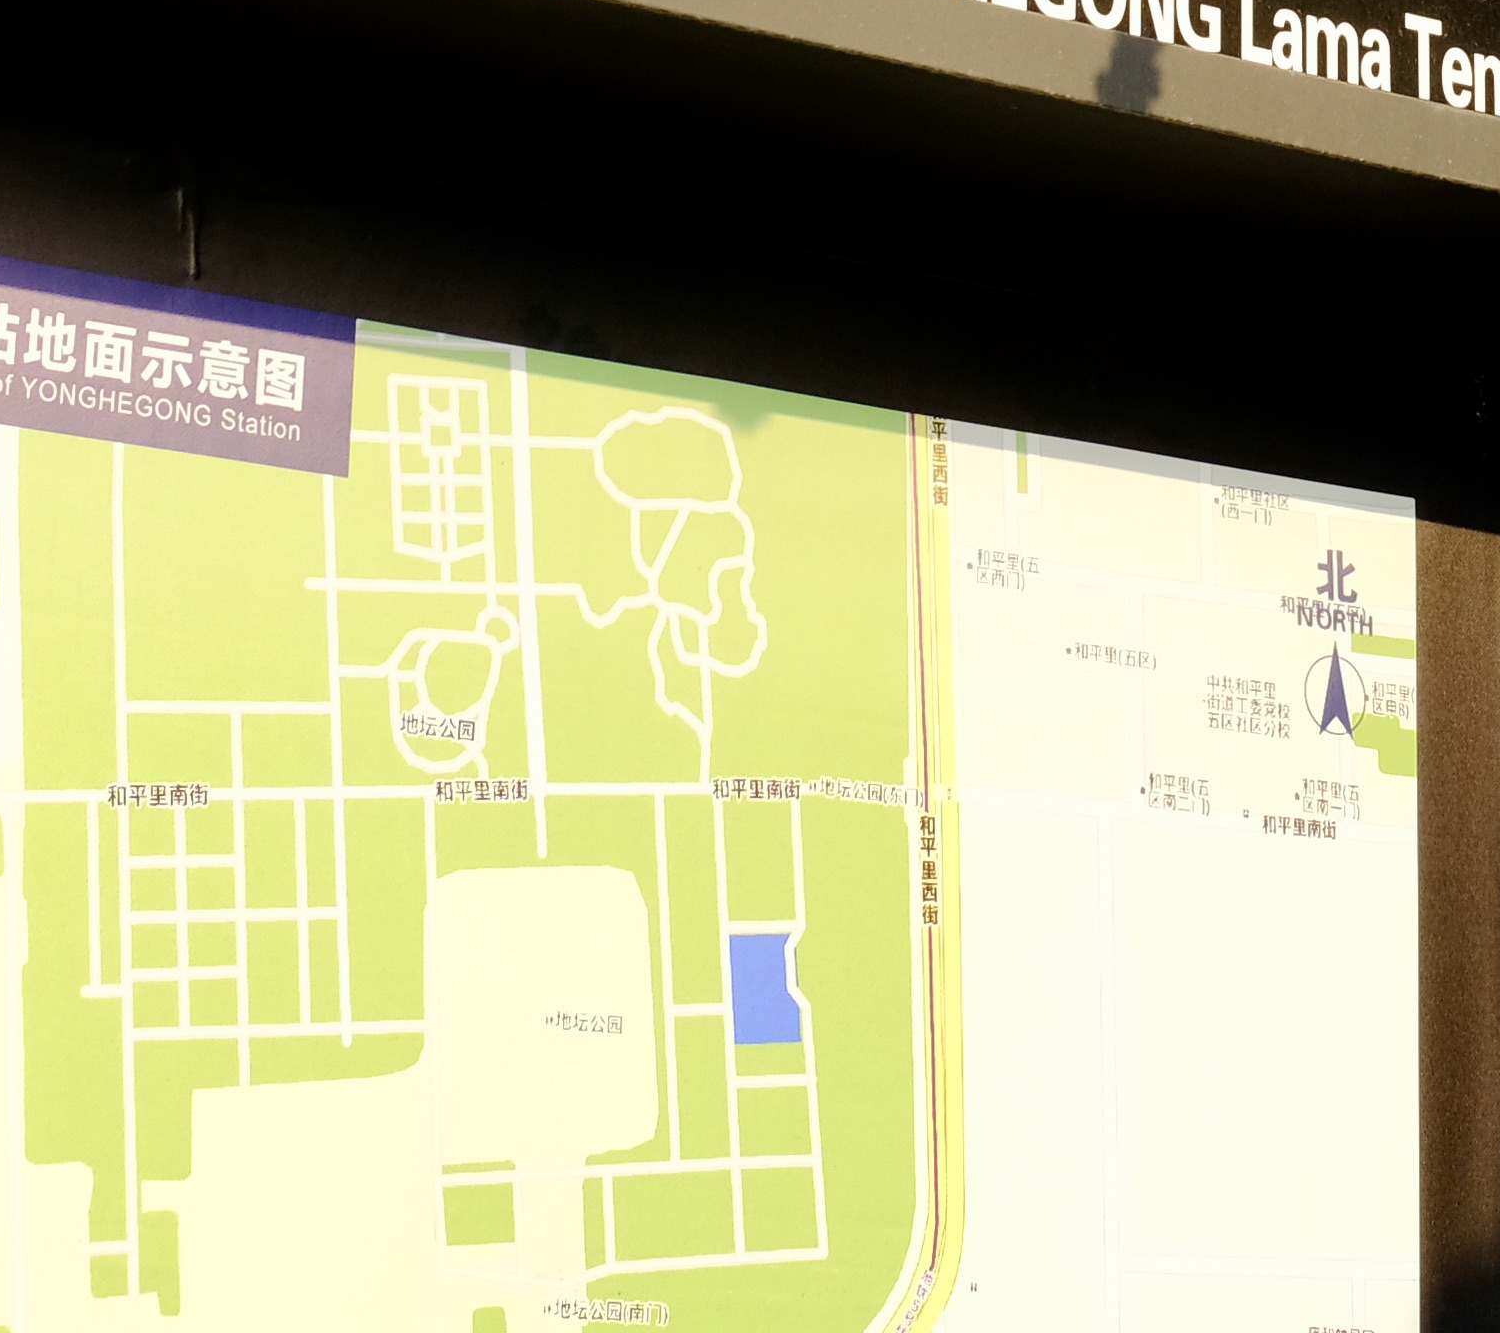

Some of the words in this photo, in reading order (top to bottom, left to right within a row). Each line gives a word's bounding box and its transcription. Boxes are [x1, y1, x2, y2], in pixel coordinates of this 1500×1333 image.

[20, 376, 212, 430] YONGHEGONG
[219, 407, 303, 443] Station
[931, 416, 949, 506] 平里西街
[1316, 548, 1359, 604] 北
[1296, 605, 1374, 638] NORTH
[399, 712, 477, 743] 地坛公园
[106, 783, 210, 809] 和平里南街
[434, 778, 529, 803] 和平里南街
[712, 777, 801, 800] 和平里南街
[1262, 814, 1337, 841] 和平里南街
[919, 814, 939, 927] 和平里西街
[554, 1010, 624, 1036] 地坛公园
